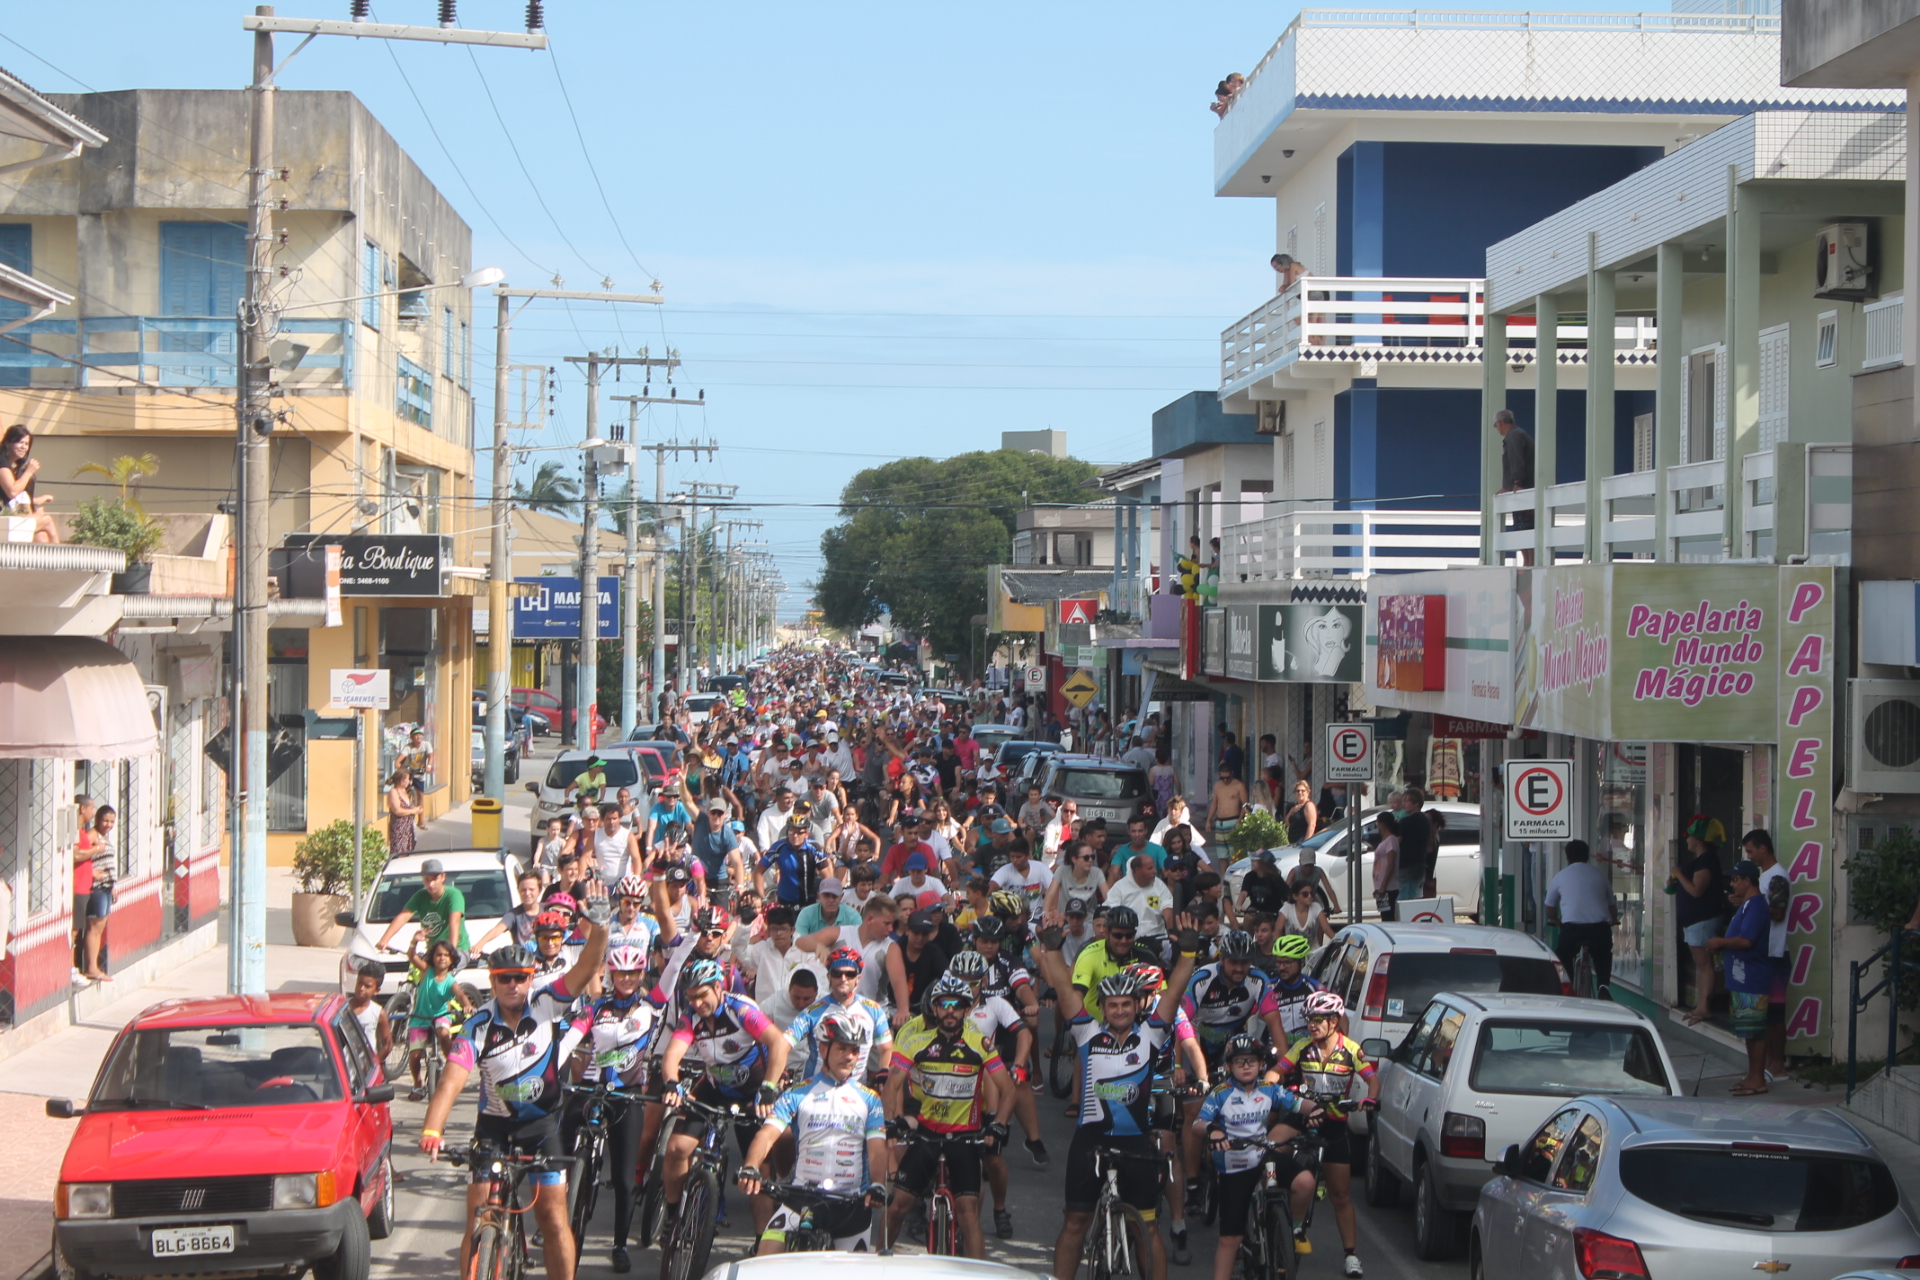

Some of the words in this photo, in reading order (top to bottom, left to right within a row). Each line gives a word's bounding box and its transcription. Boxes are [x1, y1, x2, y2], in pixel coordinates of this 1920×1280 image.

[358, 545, 434, 579] Boutique
[1553, 579, 1584, 632] Papelaria
[1628, 600, 1763, 644] Papelaria
[1543, 631, 1571, 694] Mundo
[1574, 623, 1608, 697] Mágico
[1673, 633, 1763, 667] Mundo
[1634, 665, 1754, 707] Mágico
[1342, 734, 1357, 757] E
[1527, 775, 1549, 808] E
[1787, 583, 1824, 1038] PAPELARIA
